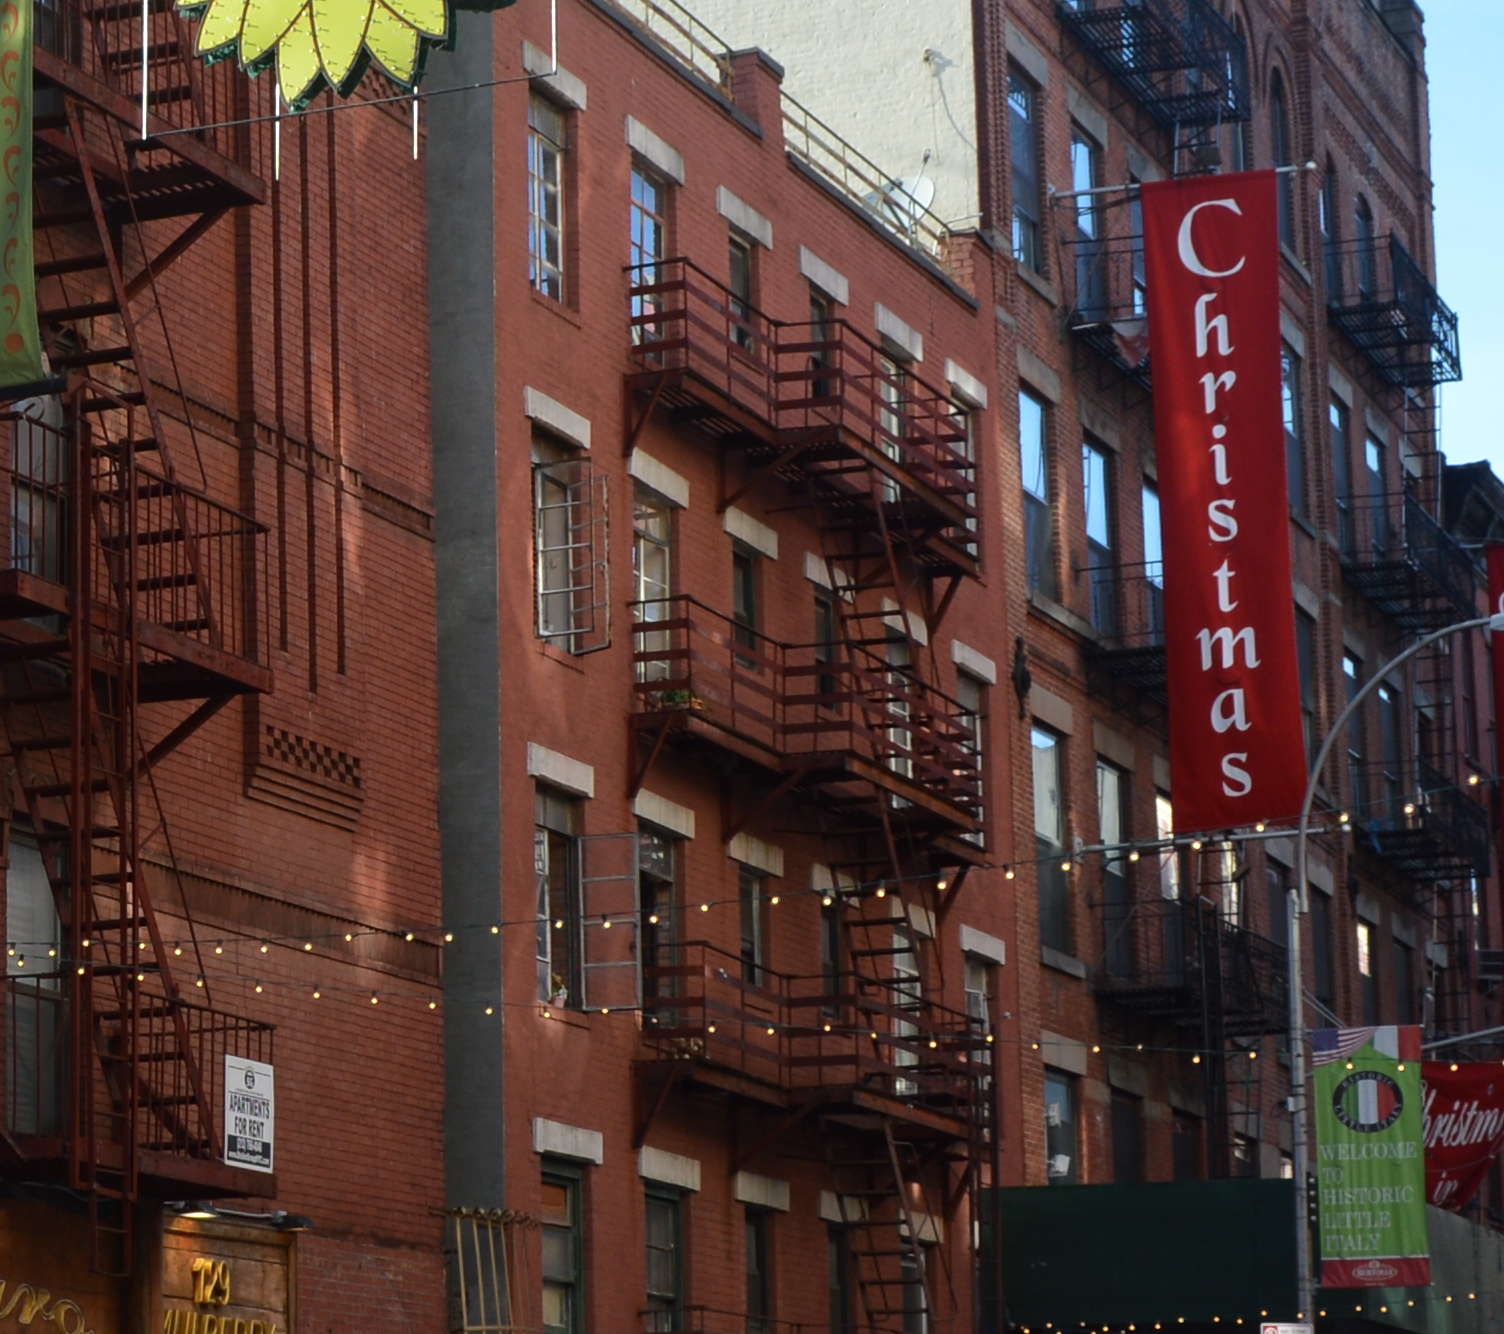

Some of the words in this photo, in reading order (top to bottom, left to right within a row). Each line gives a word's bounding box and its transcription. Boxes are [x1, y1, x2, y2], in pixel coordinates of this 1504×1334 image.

[1176, 197, 1262, 799] Christmas
[229, 1094, 271, 1120] APARTMENTS
[234, 1115, 248, 1136] FOR
[248, 1118, 265, 1140] RENT
[1320, 1141, 1418, 1161] WELCOME
[1323, 1167, 1345, 1184] TO
[1323, 1186, 1414, 1205] HISTORIC
[1324, 1211, 1392, 1229] LITTLE
[1326, 1233, 1381, 1252] ITALY
[192, 1257, 232, 1306] 129
